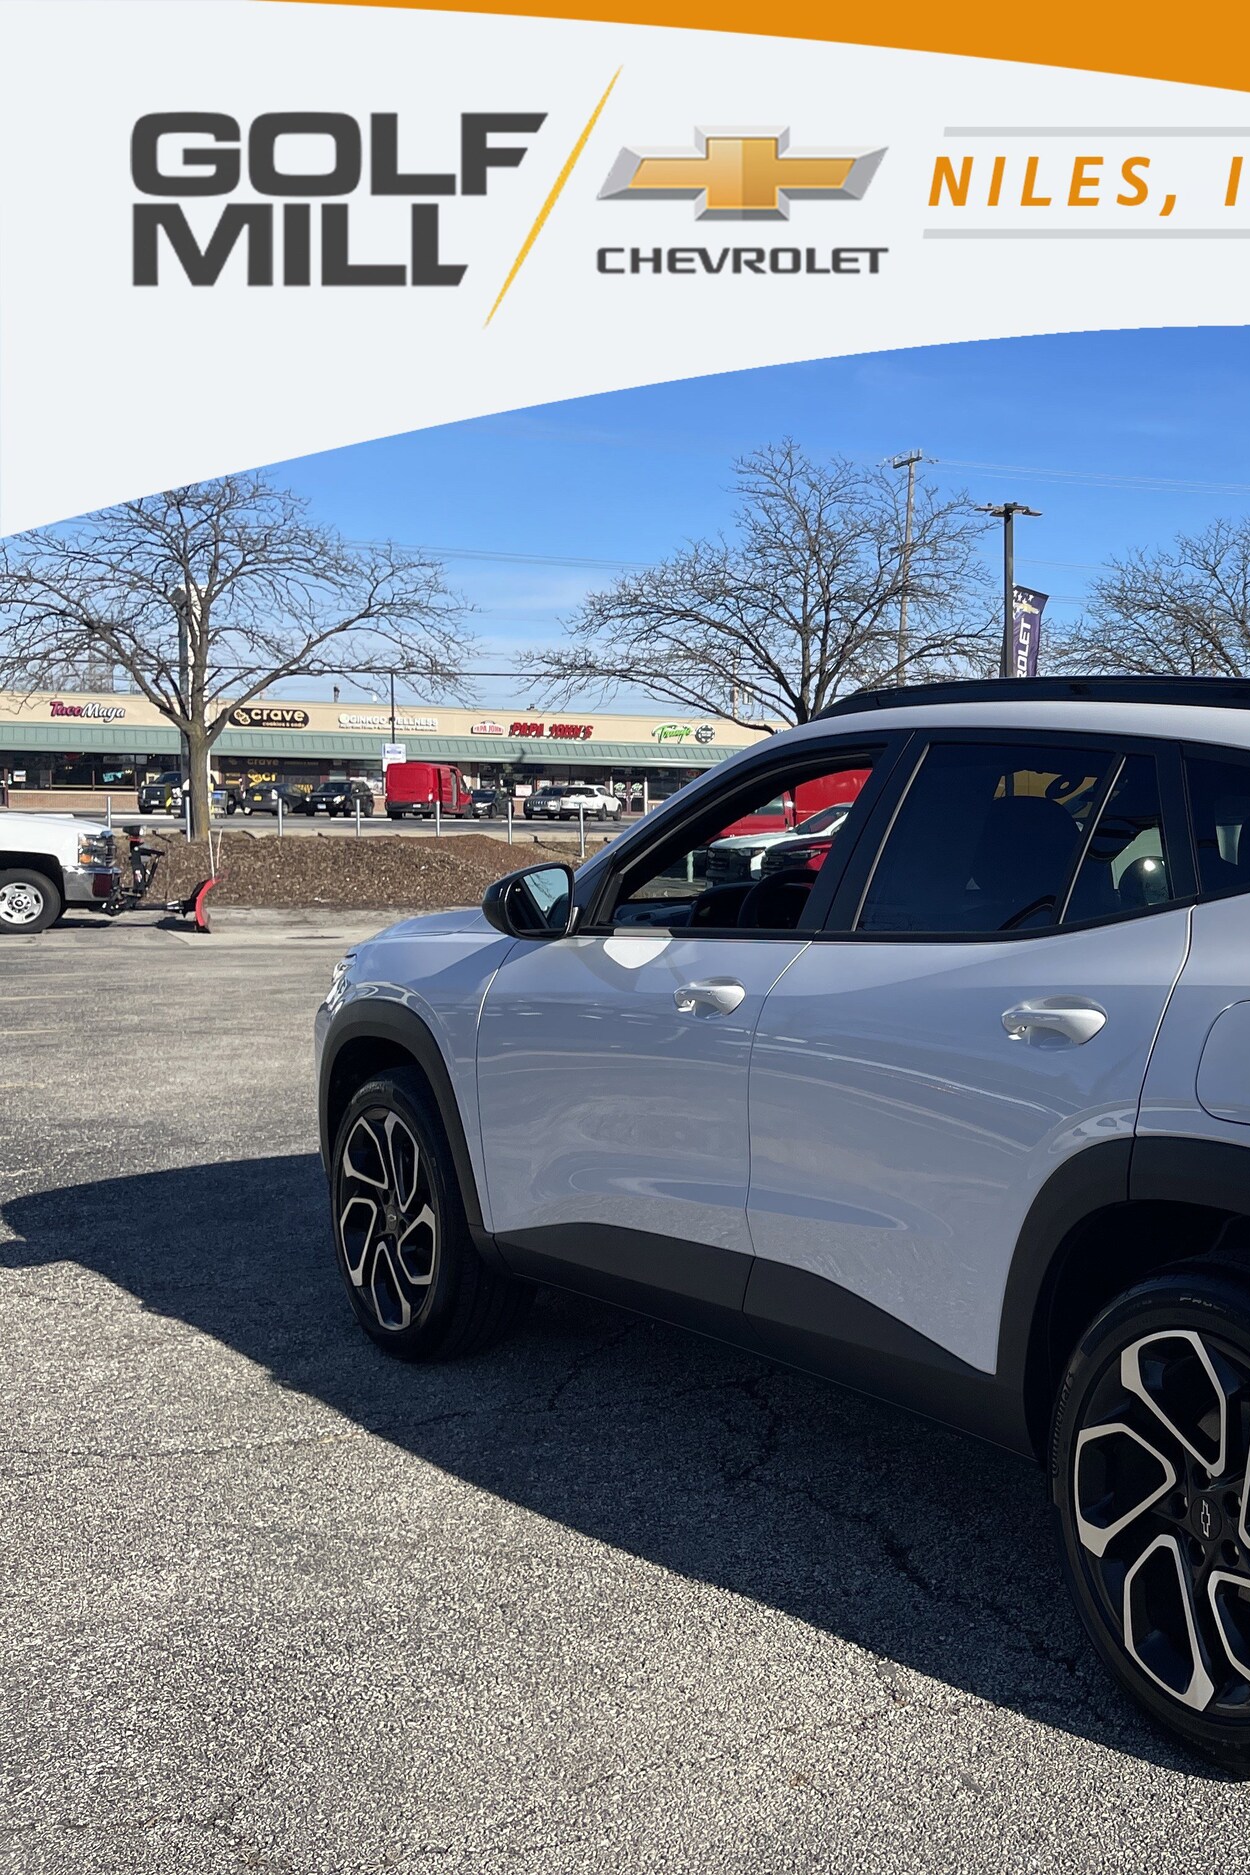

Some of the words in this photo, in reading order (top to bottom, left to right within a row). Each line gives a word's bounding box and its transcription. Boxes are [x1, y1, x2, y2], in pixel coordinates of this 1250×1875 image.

[1016, 617, 1032, 678] ROLET
[251, 709, 305, 721] crave
[509, 722, 544, 737] PAPA
